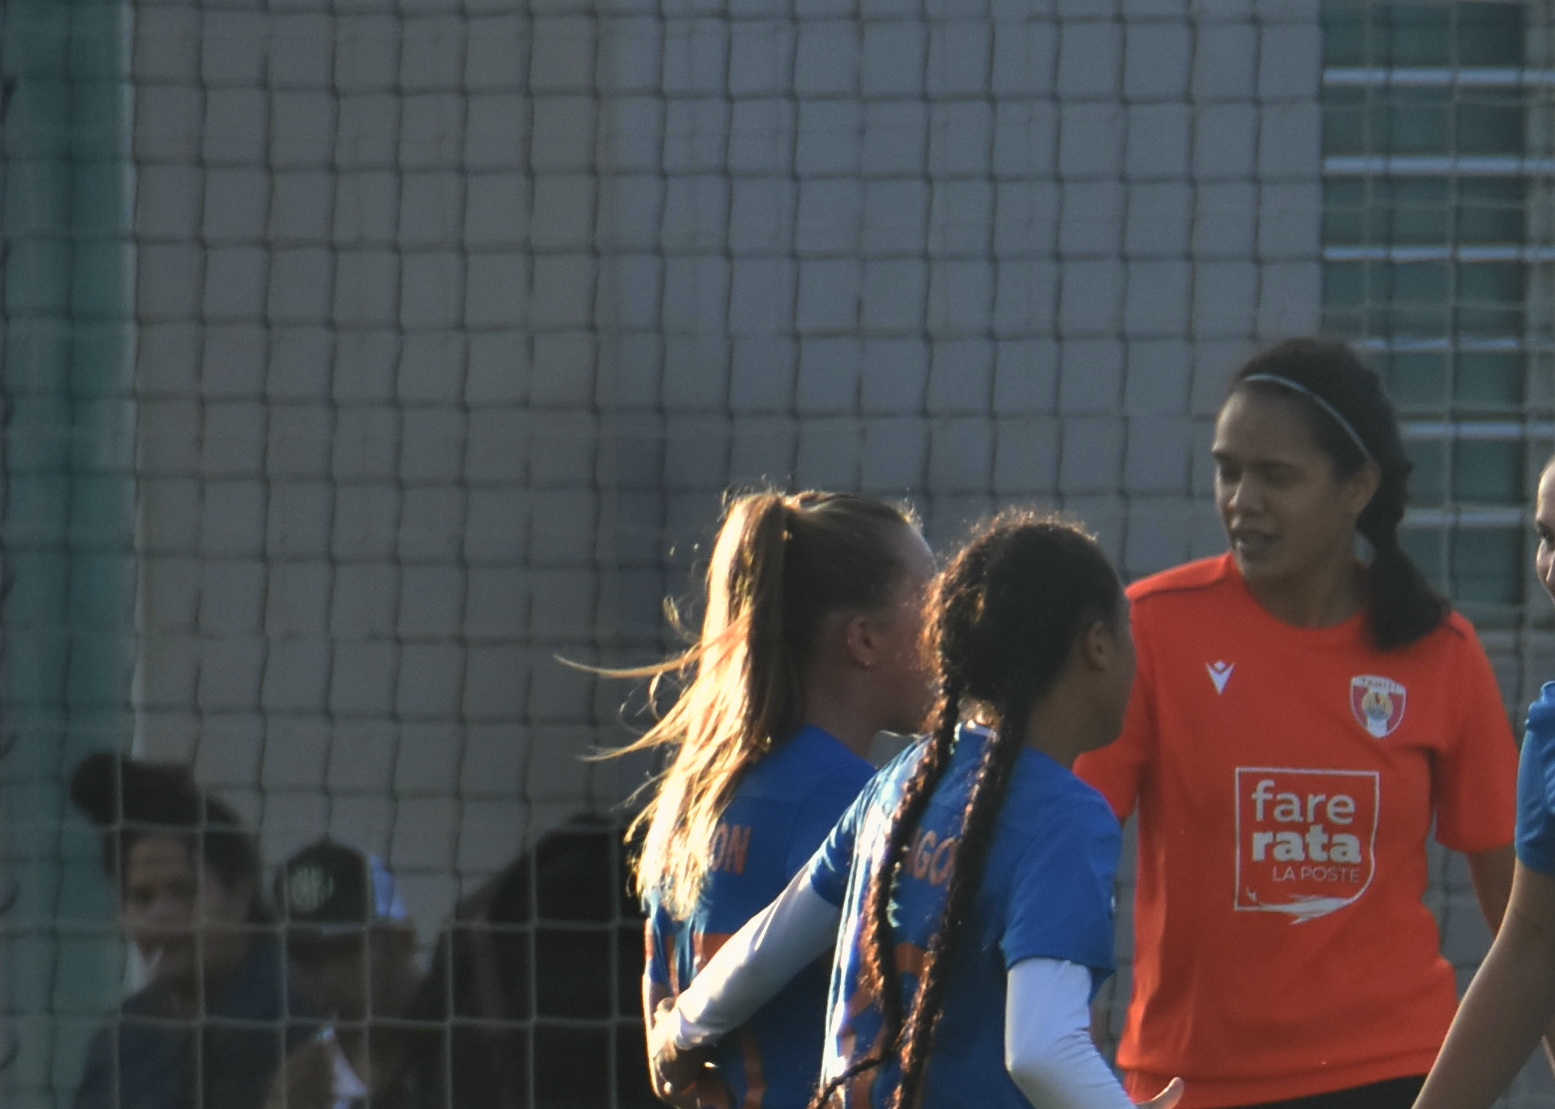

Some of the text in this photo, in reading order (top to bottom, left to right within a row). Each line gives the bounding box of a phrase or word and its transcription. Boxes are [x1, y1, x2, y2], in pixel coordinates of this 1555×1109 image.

[1252, 779, 1356, 825] fare
[708, 823, 752, 875] ON
[1252, 824, 1362, 864] rata
[1272, 867, 1360, 882] LA POSTE
